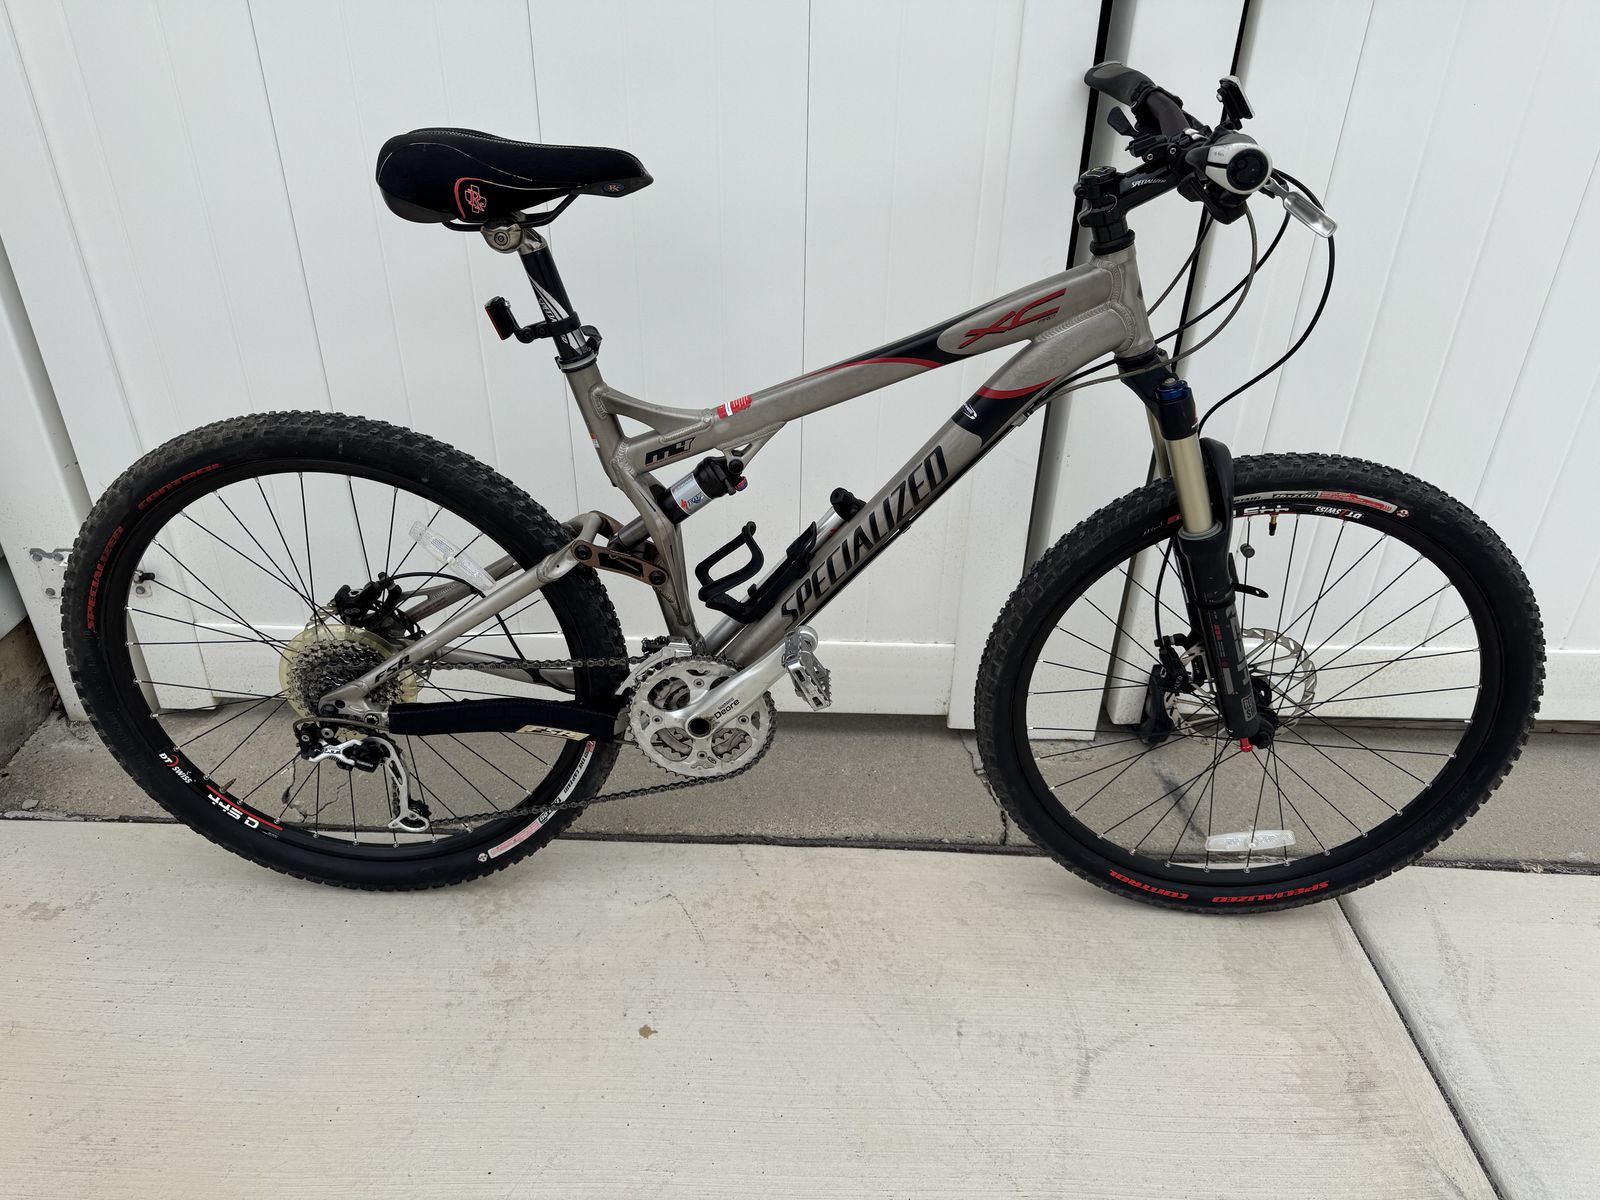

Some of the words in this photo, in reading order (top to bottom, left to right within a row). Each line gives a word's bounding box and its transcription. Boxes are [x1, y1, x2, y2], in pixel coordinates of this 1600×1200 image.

[138, 463, 222, 510] CONTROL
[1315, 505, 1342, 515] SWISS
[1345, 511, 1363, 519] DT
[781, 445, 949, 623] SPECIALIZED
[86, 526, 124, 630] SPECIALIZED
[375, 654, 410, 683] FSR
[714, 699, 740, 719] Deore
[158, 752, 173, 764] DT
[172, 765, 193, 784] SWISS
[1108, 869, 1190, 900] CONTROL
[1211, 880, 1330, 903] SPECIALIZED
